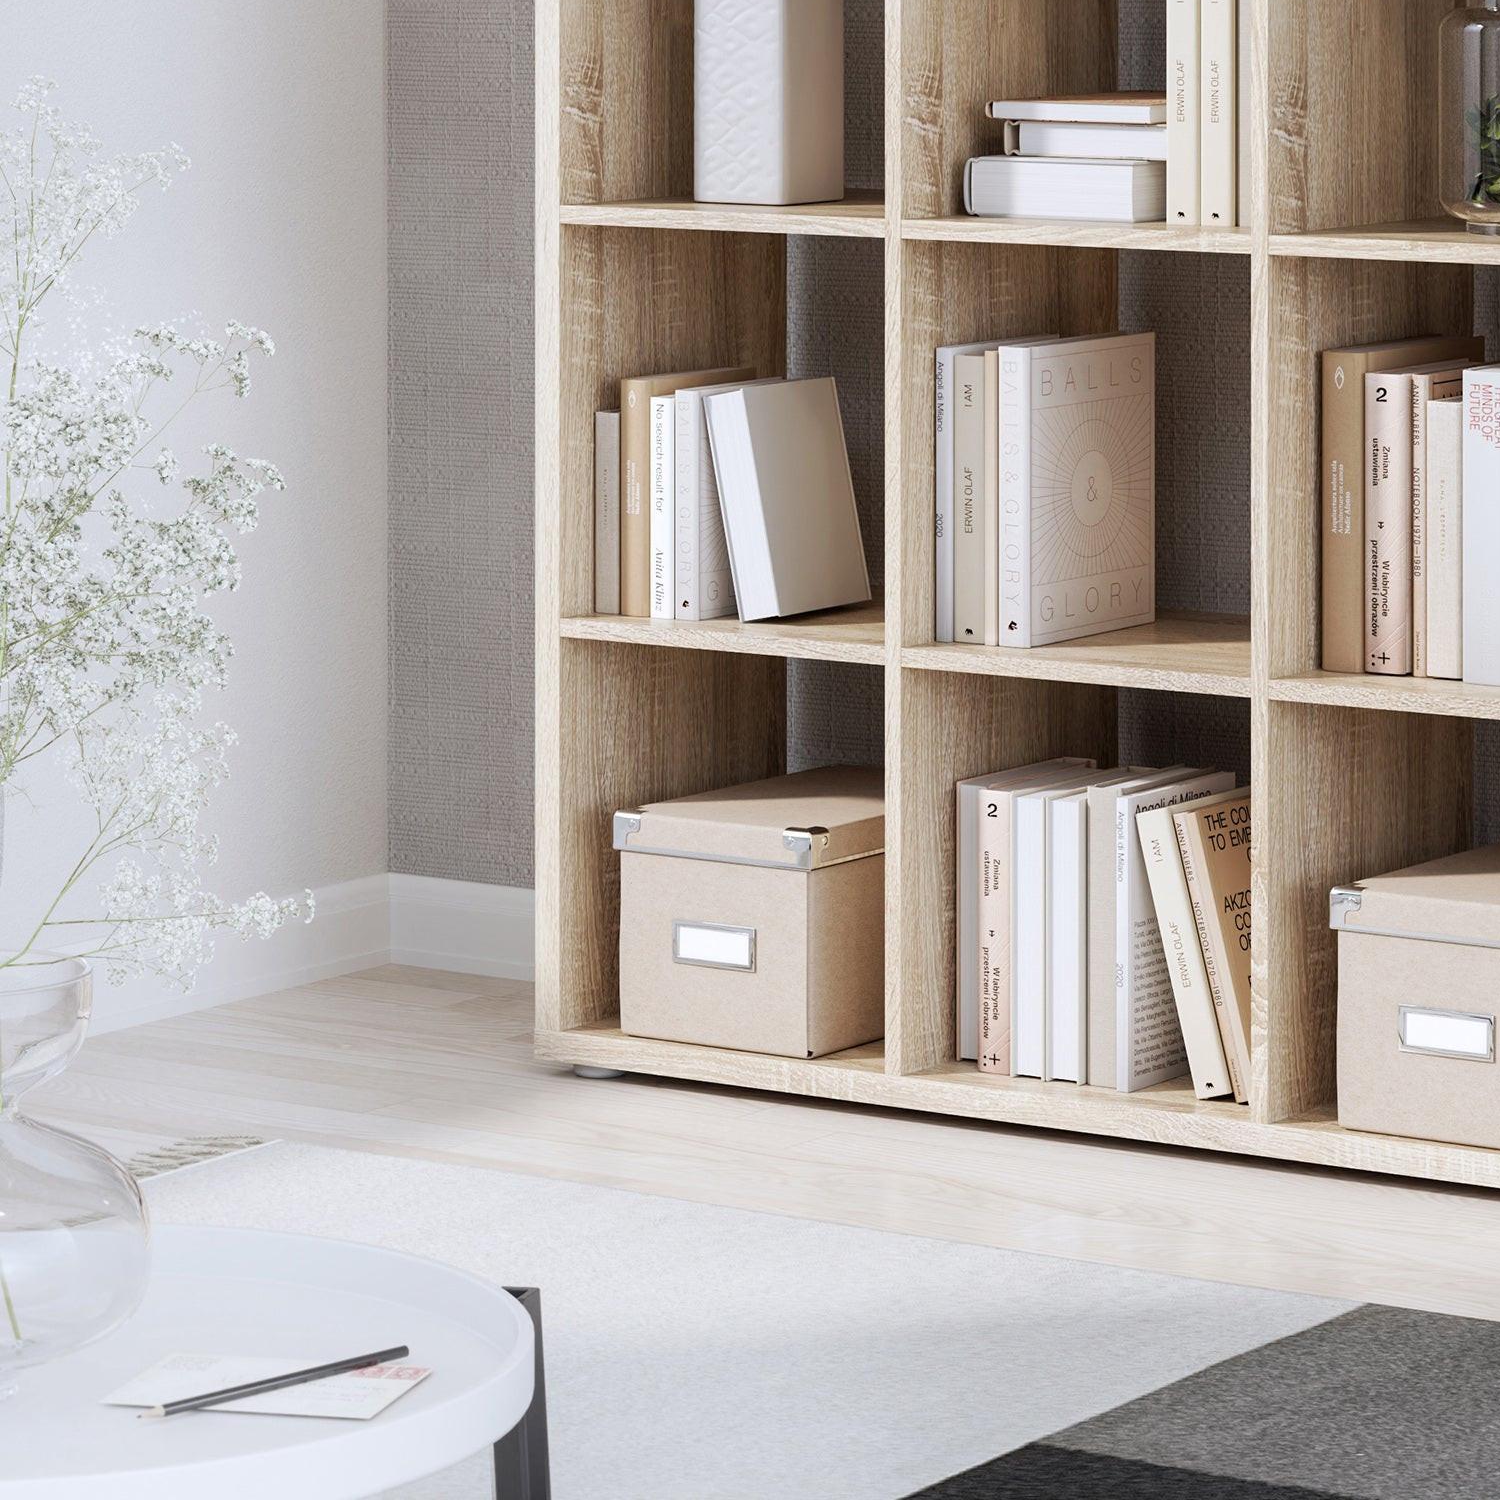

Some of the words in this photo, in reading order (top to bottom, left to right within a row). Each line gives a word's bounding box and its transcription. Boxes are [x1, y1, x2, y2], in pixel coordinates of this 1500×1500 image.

[1176, 59, 1185, 86] OLAF
[1210, 60, 1219, 88] OLAF
[1176, 88, 1186, 123] ERWIN
[1210, 90, 1219, 124] ERWIN
[936, 361, 945, 390] Angoli
[1041, 357, 1142, 397] BALLS
[937, 391, 945, 401] di
[964, 383, 972, 401] AM
[1375, 387, 1388, 403] 2
[1412, 383, 1420, 408] ANNI
[1469, 383, 1482, 431] FUTURE
[1481, 384, 1494, 422] MINDS
[655, 403, 665, 420] No
[937, 403, 945, 433] Milano
[655, 422, 665, 460] search
[1412, 411, 1420, 446] ALBERS
[1481, 425, 1494, 442] OF
[1003, 470, 1019, 484] &
[1372, 437, 1380, 487] ustawienia
[1382, 446, 1390, 480] Zmiana
[655, 461, 665, 495] result
[964, 467, 973, 497] OLAF
[1086, 475, 1098, 502] &
[655, 496, 664, 514] for
[1412, 467, 1421, 522] NOTEBOOK
[935, 513, 944, 538] 2020
[964, 499, 973, 534] ERWIN
[655, 548, 665, 582] Anita
[1003, 500, 1020, 607] GLORY
[1371, 539, 1379, 591] przestrzeni
[1381, 560, 1390, 571] W
[1040, 578, 1143, 622] GLORY
[1380, 572, 1390, 617] labiryncie
[1371, 597, 1380, 637] obrazów
[987, 803, 998, 818] 2
[1117, 811, 1125, 840] Angoli
[1204, 811, 1228, 832] THE
[1151, 839, 1162, 856] AM
[1208, 833, 1227, 852] TO
[992, 858, 1001, 891] Zmiana
[1117, 853, 1125, 882] Milano
[1175, 822, 1185, 845] ANNI
[1181, 847, 1194, 882] ALBERS
[1193, 901, 1210, 953] NOTEBOOK
[1169, 921, 1183, 950] OLAF
[982, 946, 990, 994] przestrzeni
[992, 966, 1001, 977] W
[1116, 962, 1124, 989] 2020
[1177, 952, 1192, 988] ERWIN
[991, 978, 1001, 1021] labiryncie
[982, 999, 990, 1039] obrazów
